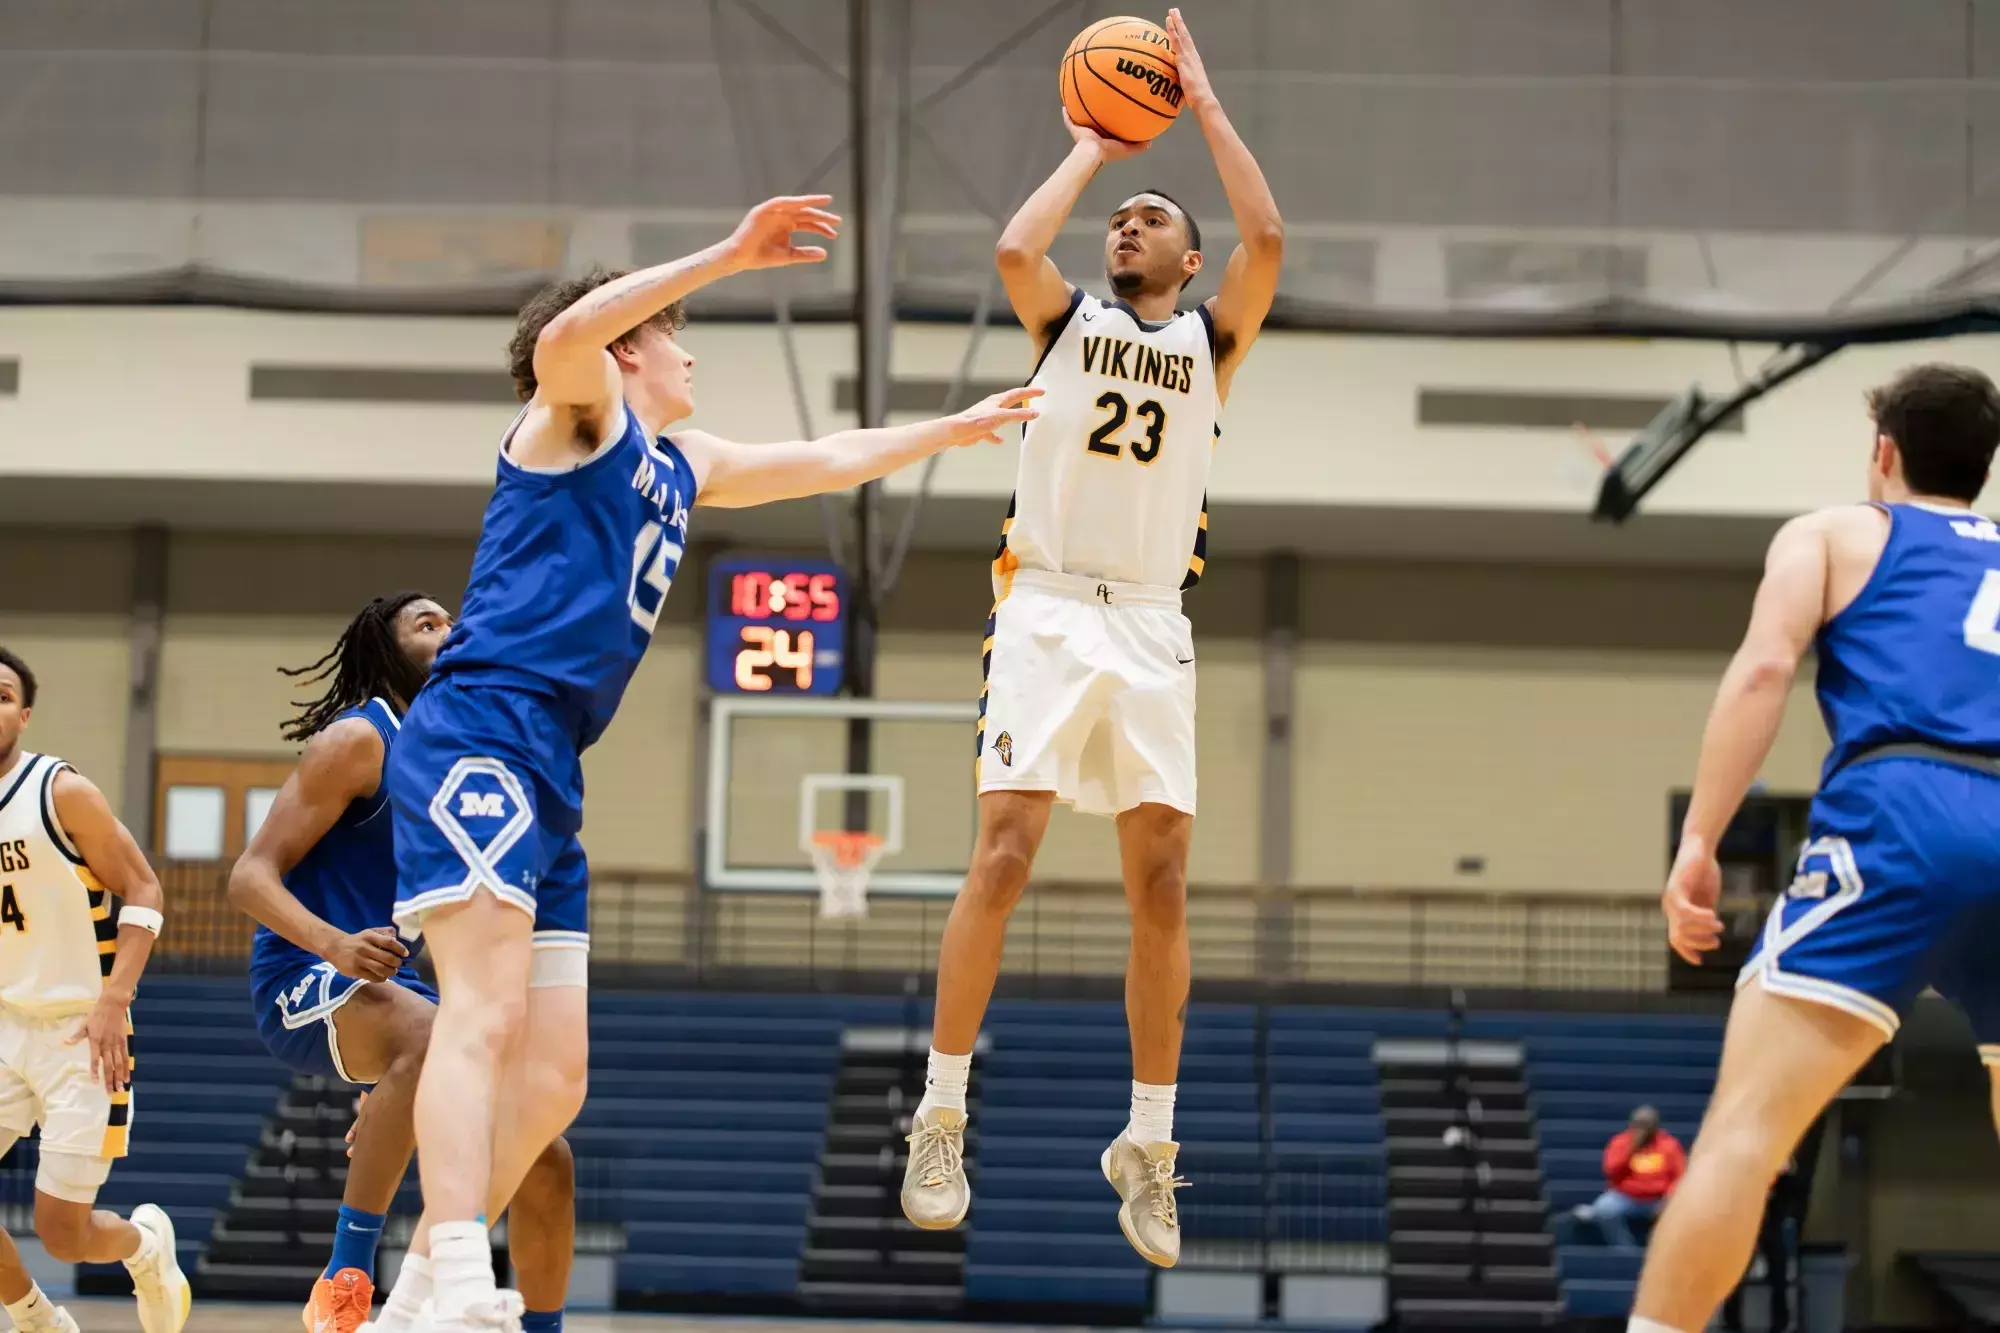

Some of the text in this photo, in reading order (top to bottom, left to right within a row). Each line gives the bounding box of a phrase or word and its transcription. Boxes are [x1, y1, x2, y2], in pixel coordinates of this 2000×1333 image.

[1116, 57, 1183, 109] Wilson
[1083, 336, 1194, 394] VIKINGS
[1087, 391, 1167, 466] 23
[627, 520, 683, 635] 15
[732, 572, 839, 622] 10:55
[735, 626, 814, 691] 24
[460, 792, 505, 817] M
